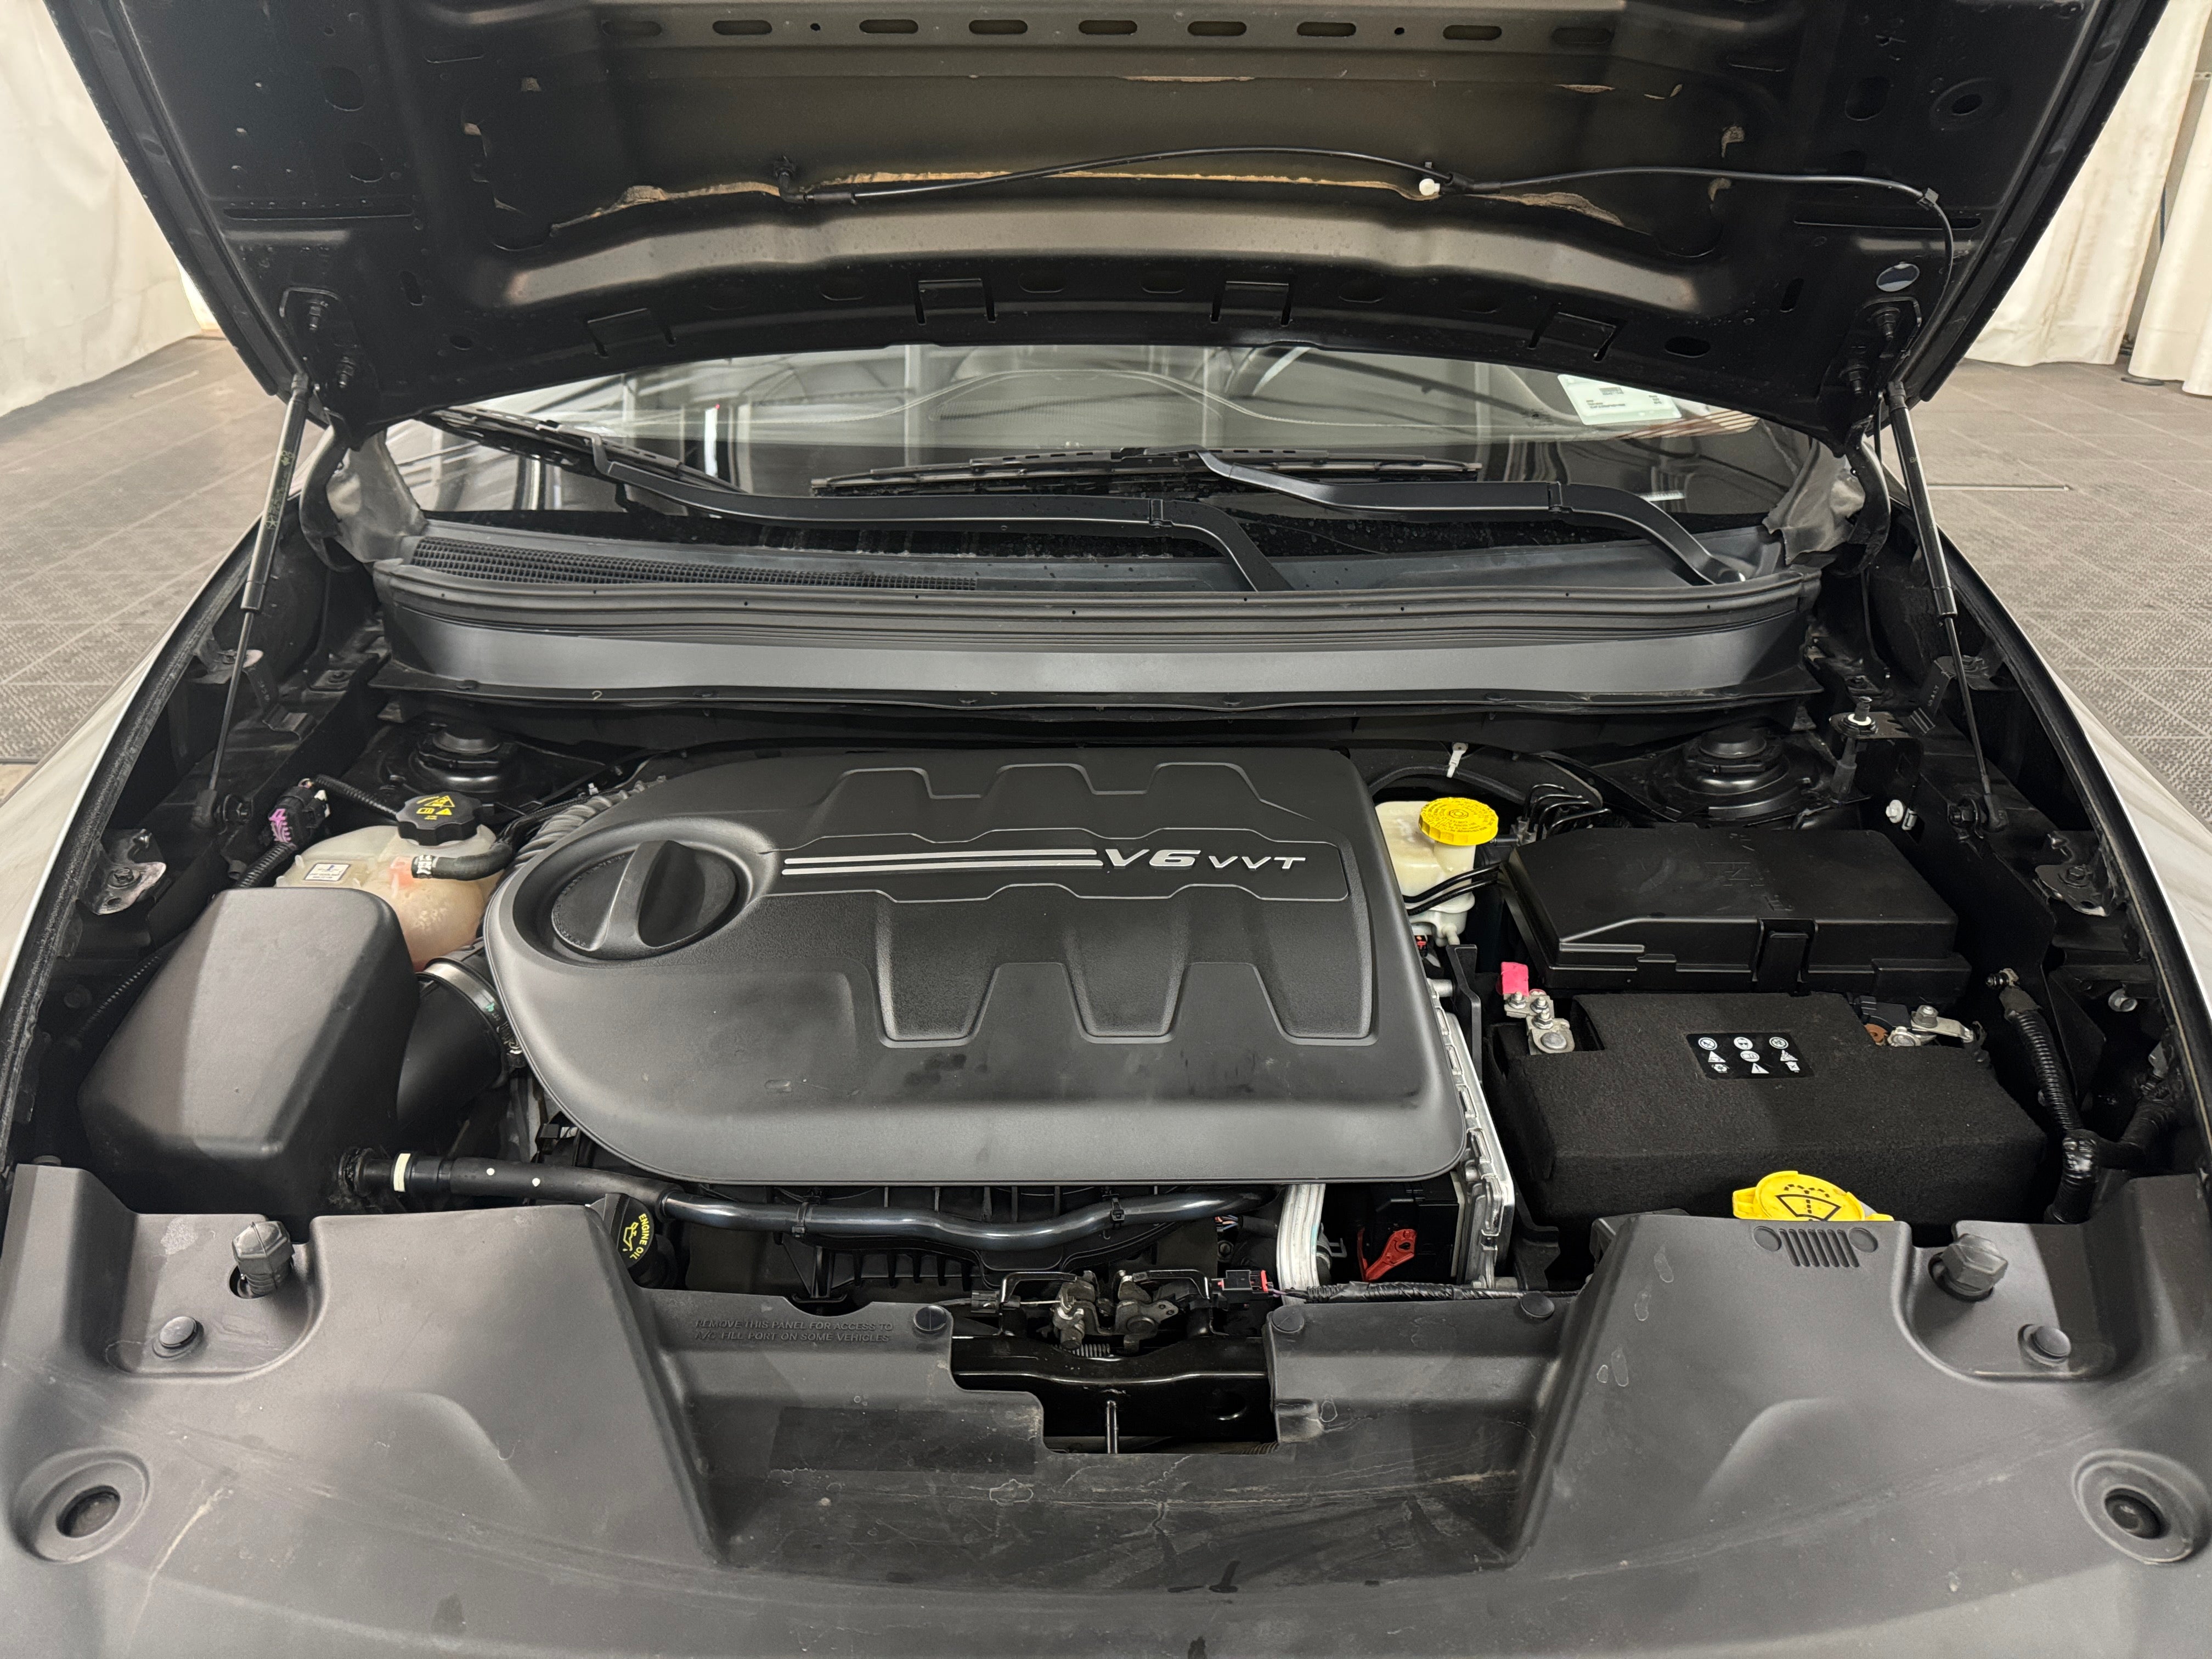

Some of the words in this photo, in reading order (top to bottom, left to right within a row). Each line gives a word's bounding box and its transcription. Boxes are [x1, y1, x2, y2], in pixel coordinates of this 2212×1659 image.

[1105, 849, 1201, 867] V6
[1208, 855, 1306, 870] VVT
[638, 1213, 650, 1245] ENGINE
[629, 1246, 644, 1260] OIL
[695, 1320, 742, 1328] REMOVE
[745, 1321, 769, 1329] THIS
[771, 1321, 805, 1329] PANEL
[809, 1322, 831, 1330] FOR
[834, 1323, 876, 1331] ACCESS
[879, 1323, 893, 1331] TO
[695, 1330, 715, 1340] A/C
[721, 1331, 743, 1340] FILL
[748, 1332, 777, 1340] PORT
[781, 1333, 797, 1341] ON
[800, 1333, 833, 1341] SOME
[837, 1334, 889, 1342] VEHICLES
